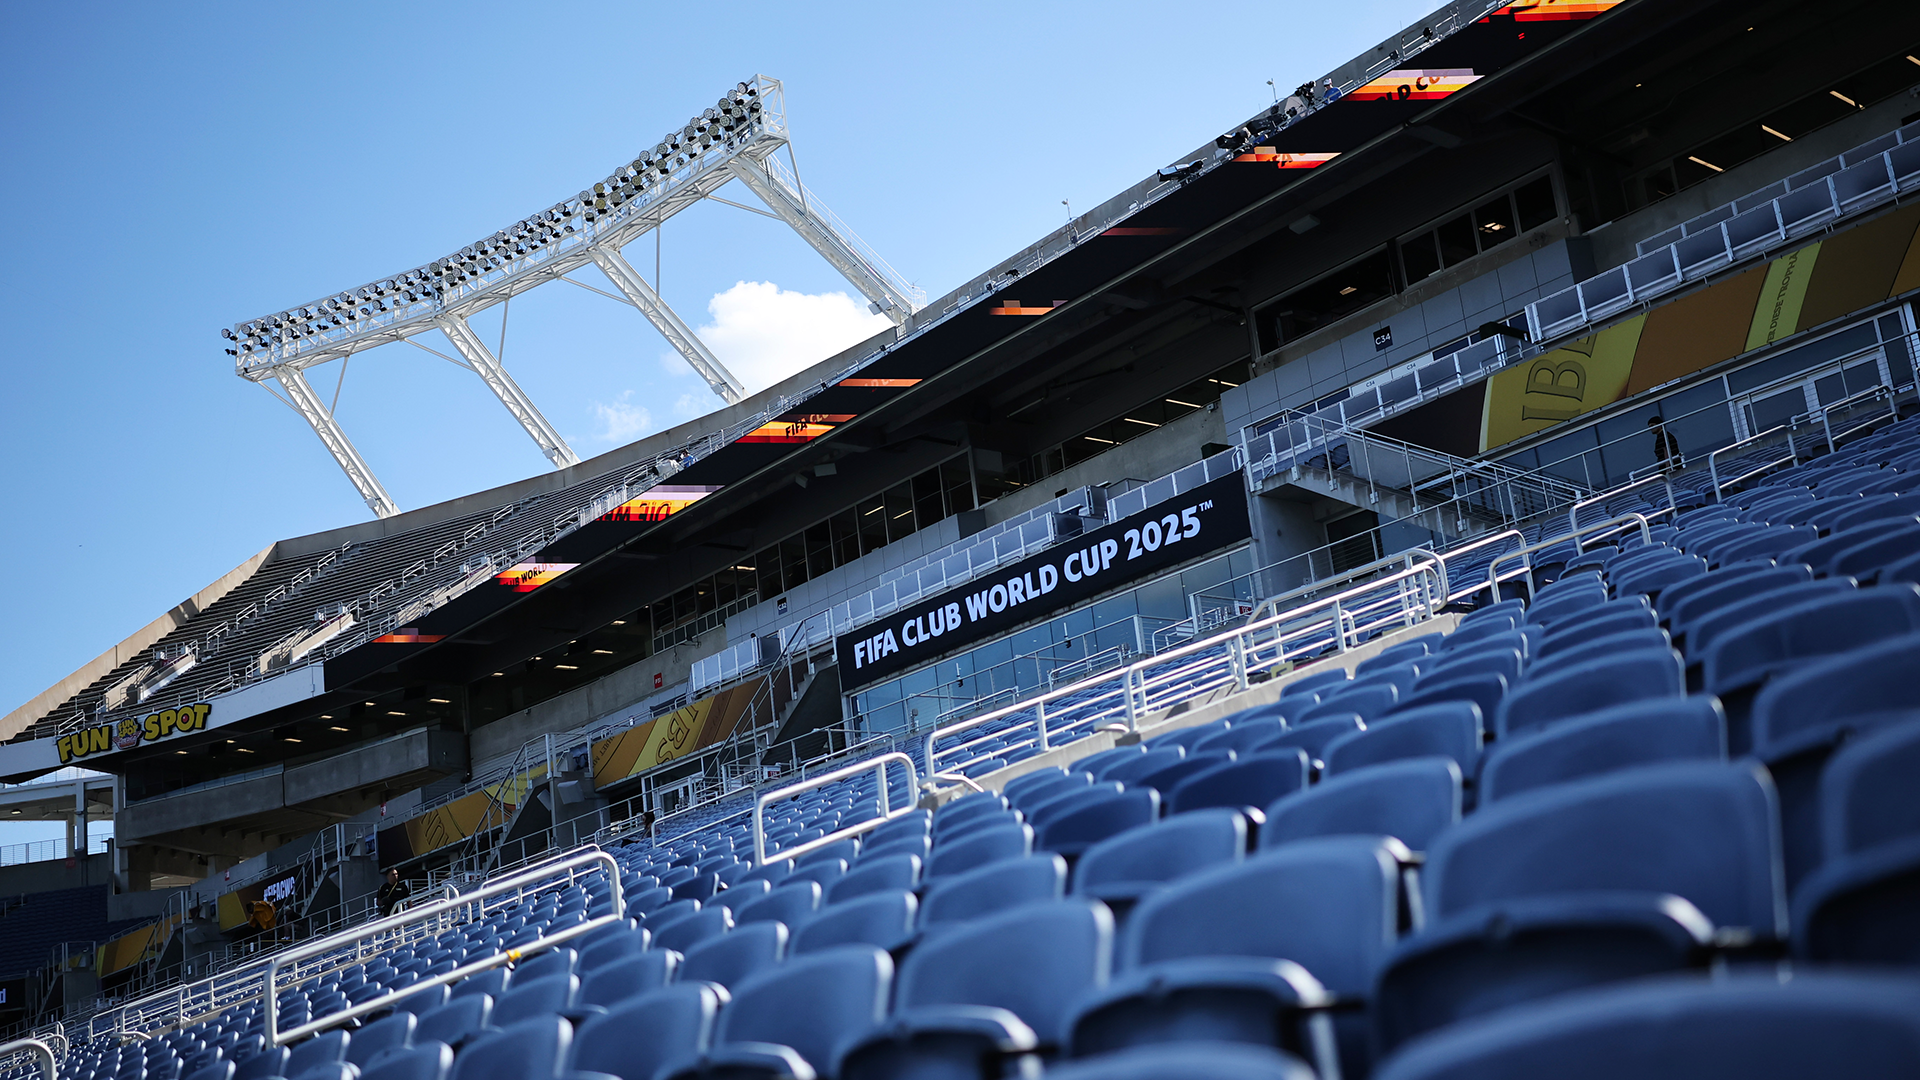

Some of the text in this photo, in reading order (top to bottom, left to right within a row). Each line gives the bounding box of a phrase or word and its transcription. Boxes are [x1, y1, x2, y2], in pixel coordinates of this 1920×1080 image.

[1769, 300, 1784, 329] DIESE
[1375, 333, 1390, 345] C34
[785, 417, 808, 439] FIFA
[520, 563, 547, 583] WORLD
[853, 628, 899, 669] FIFA
[901, 602, 962, 647] CLUB
[965, 564, 1058, 622] WORLD
[1063, 539, 1118, 582] CUP
[56, 703, 210, 763] FUN SPOT
[118, 718, 134, 731] FUN
[118, 724, 137, 738] SPOT
